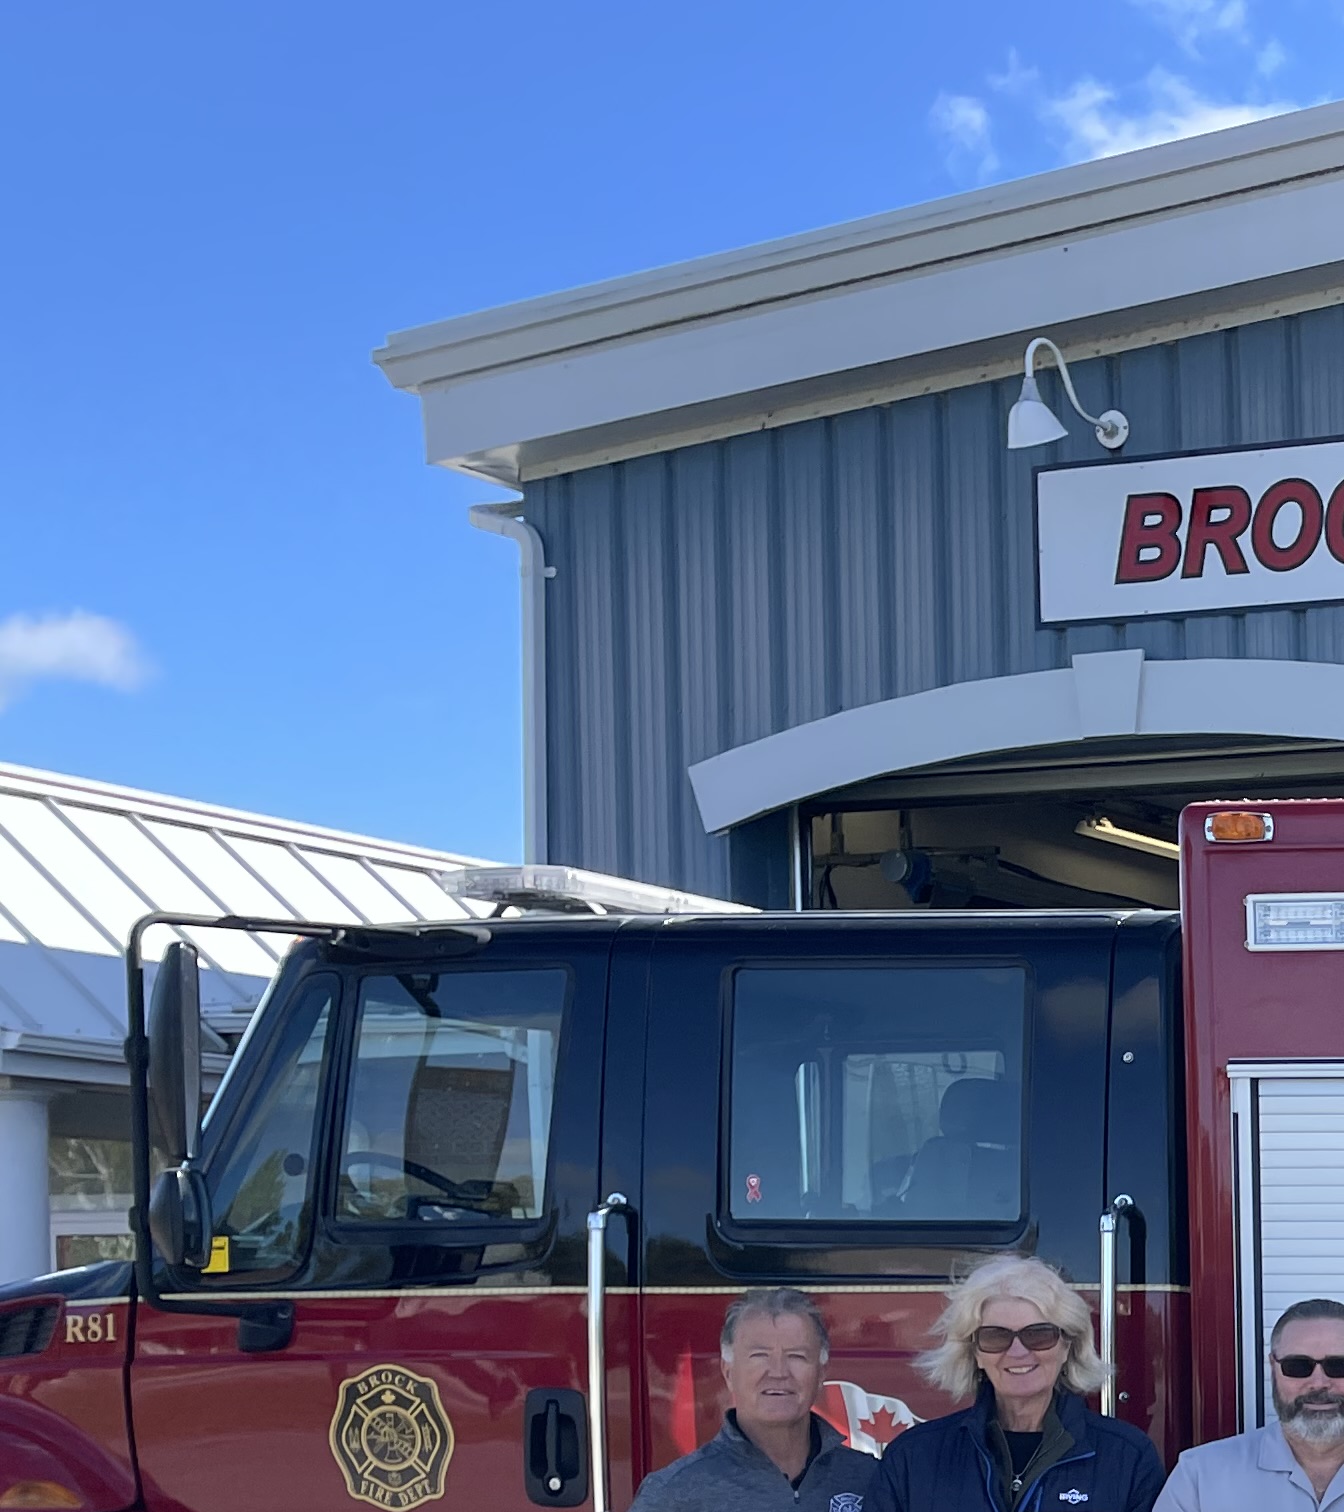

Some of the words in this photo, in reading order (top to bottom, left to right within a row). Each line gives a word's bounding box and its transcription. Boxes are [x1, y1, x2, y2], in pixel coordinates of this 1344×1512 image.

[65, 1312, 118, 1344] R81
[356, 1371, 418, 1395] BROCK
[360, 1481, 393, 1505] FIRE
